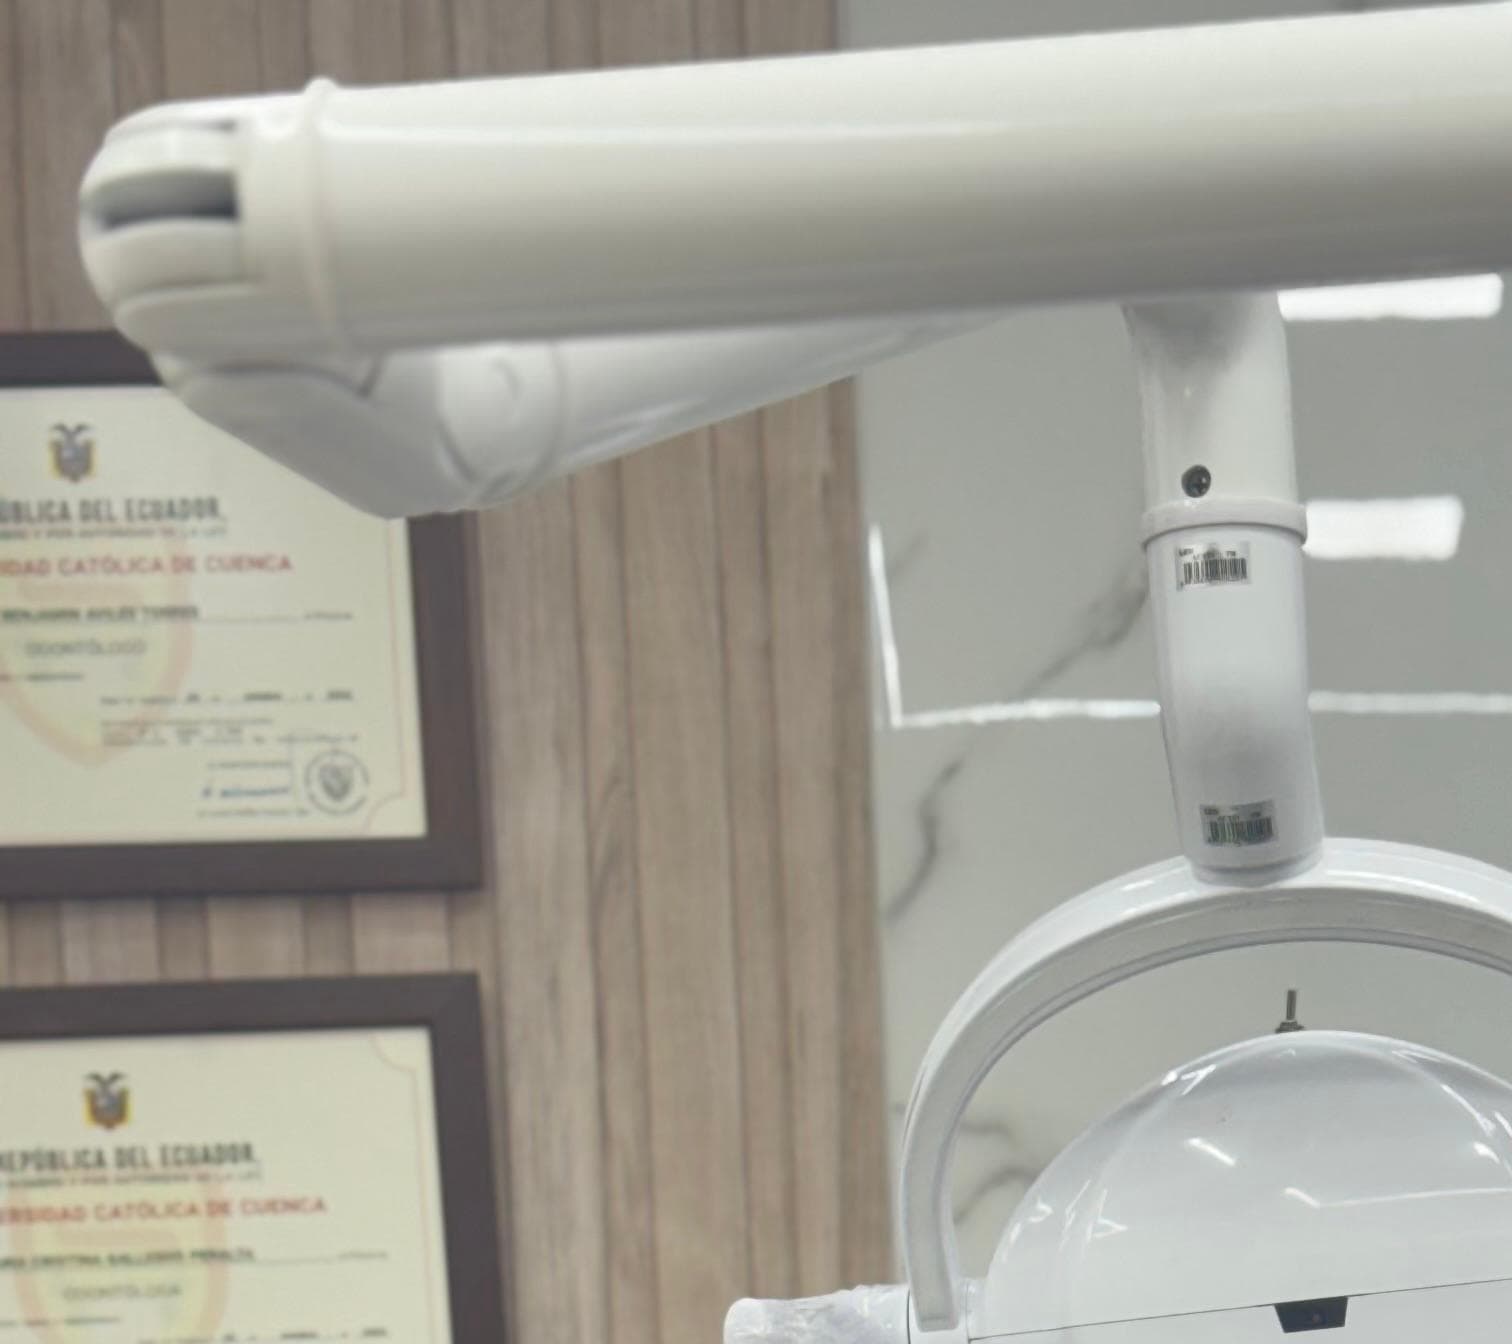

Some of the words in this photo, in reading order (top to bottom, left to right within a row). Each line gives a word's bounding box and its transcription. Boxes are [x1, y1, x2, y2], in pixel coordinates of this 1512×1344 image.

[78, 497, 118, 523] DEL
[58, 553, 164, 577] CATÓLICA
[170, 555, 197, 575] DE
[205, 553, 294, 575] CUENCA
[114, 1146, 151, 1170] DEL
[94, 1200, 199, 1222] CATÓLICA
[206, 1199, 232, 1218] DE
[240, 1195, 328, 1217] CUENCA
